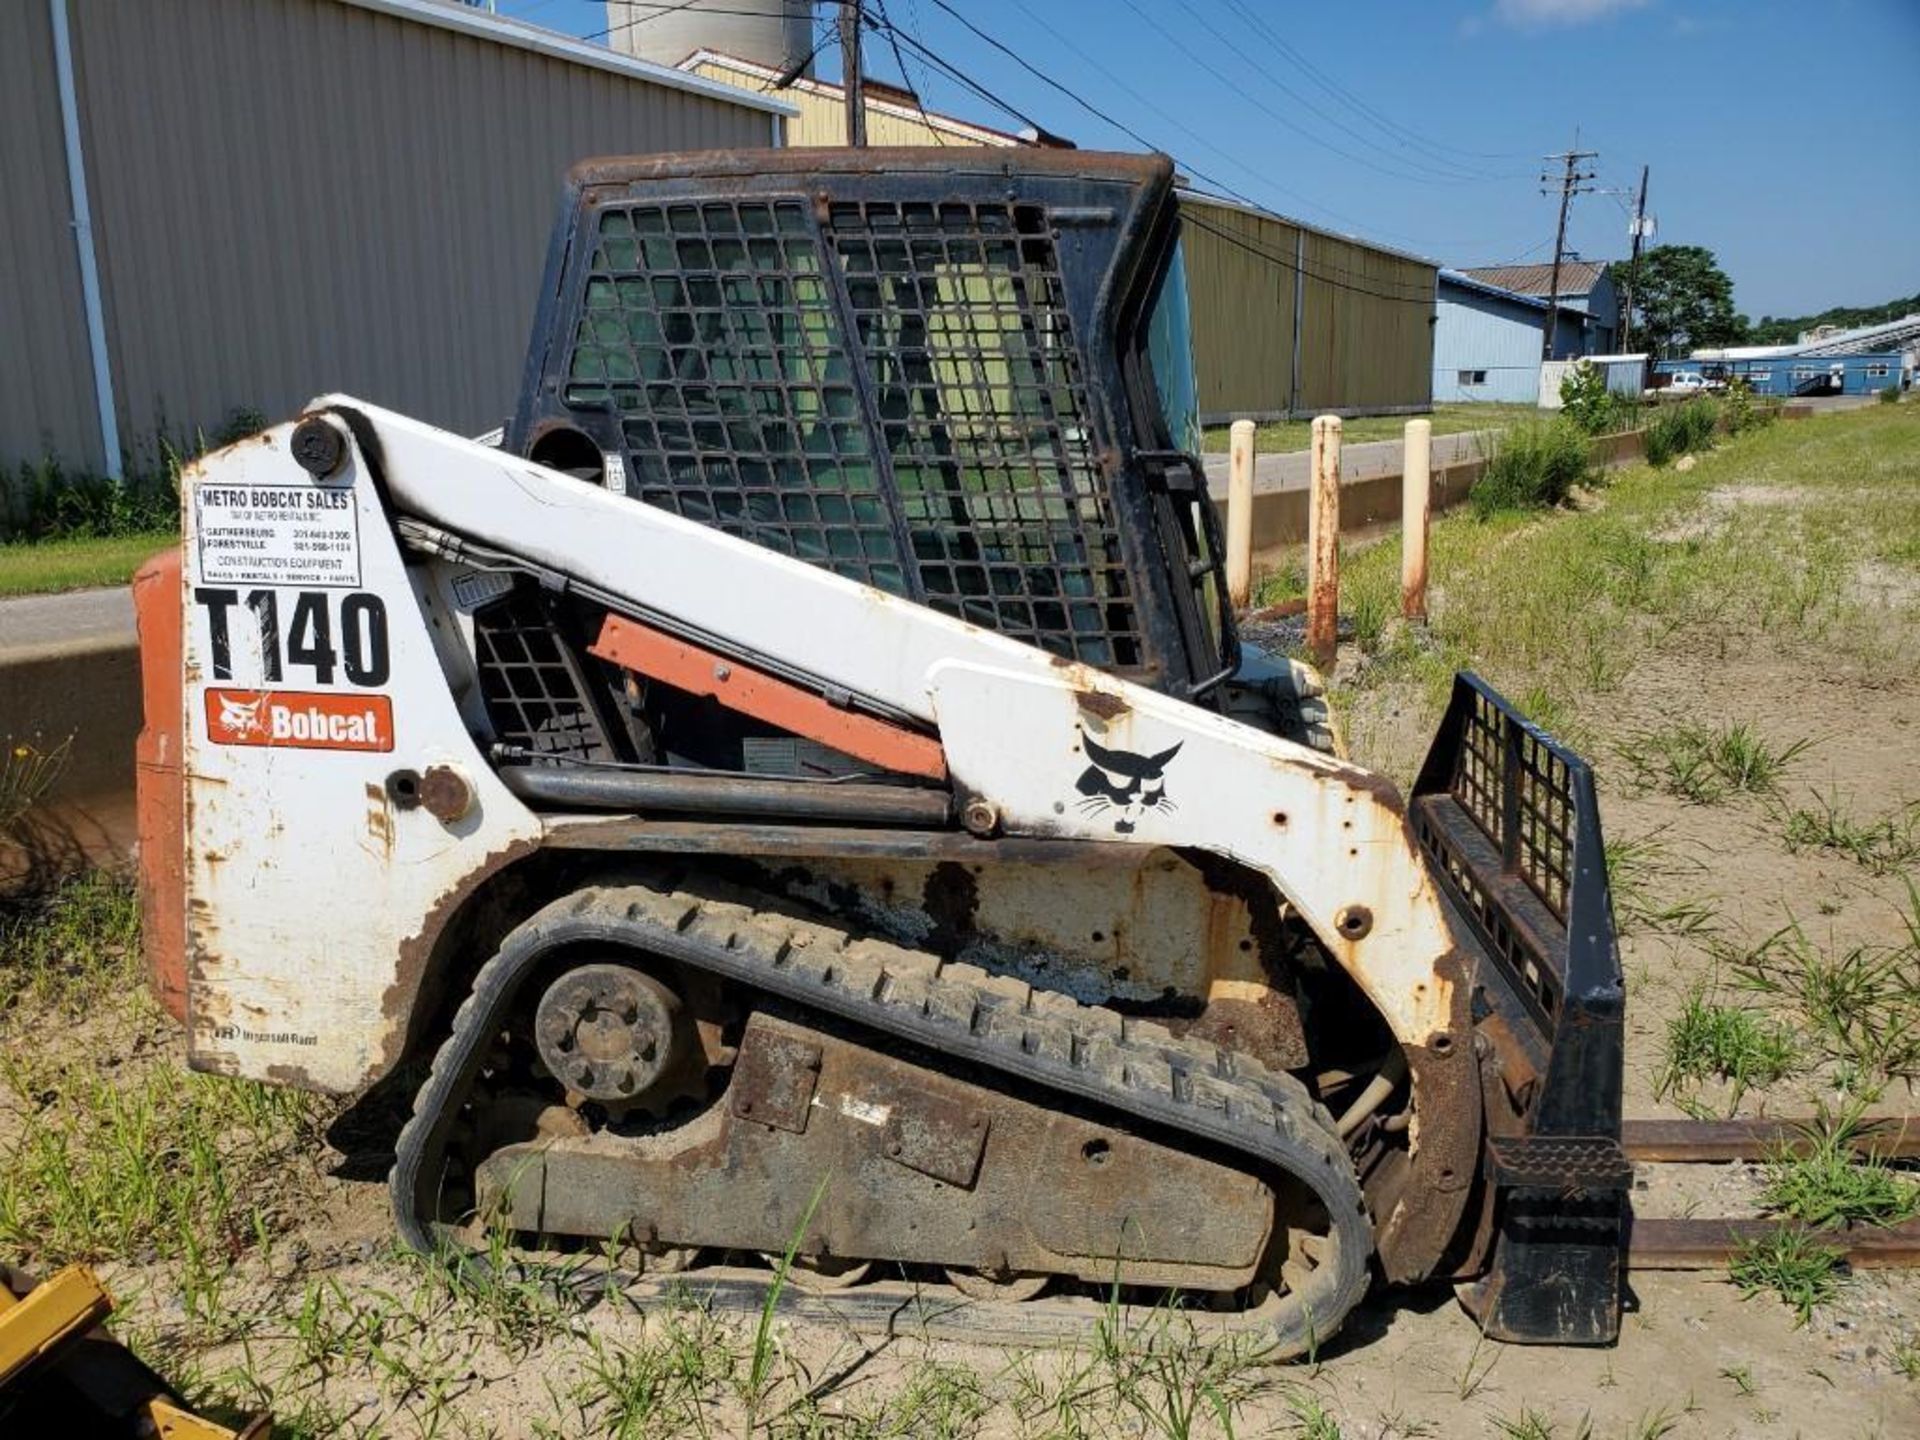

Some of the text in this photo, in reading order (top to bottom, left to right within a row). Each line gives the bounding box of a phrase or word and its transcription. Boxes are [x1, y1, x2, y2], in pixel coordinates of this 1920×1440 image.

[202, 490, 348, 510] METRO BOBCAT SALES
[207, 528, 275, 538] GAITHERSBURG
[207, 539, 266, 549] FORESTVILLE
[218, 556, 342, 570] CONSTRUCTION EQUIPMENT
[194, 588, 390, 687] T140
[270, 706, 378, 743] Bobcat
